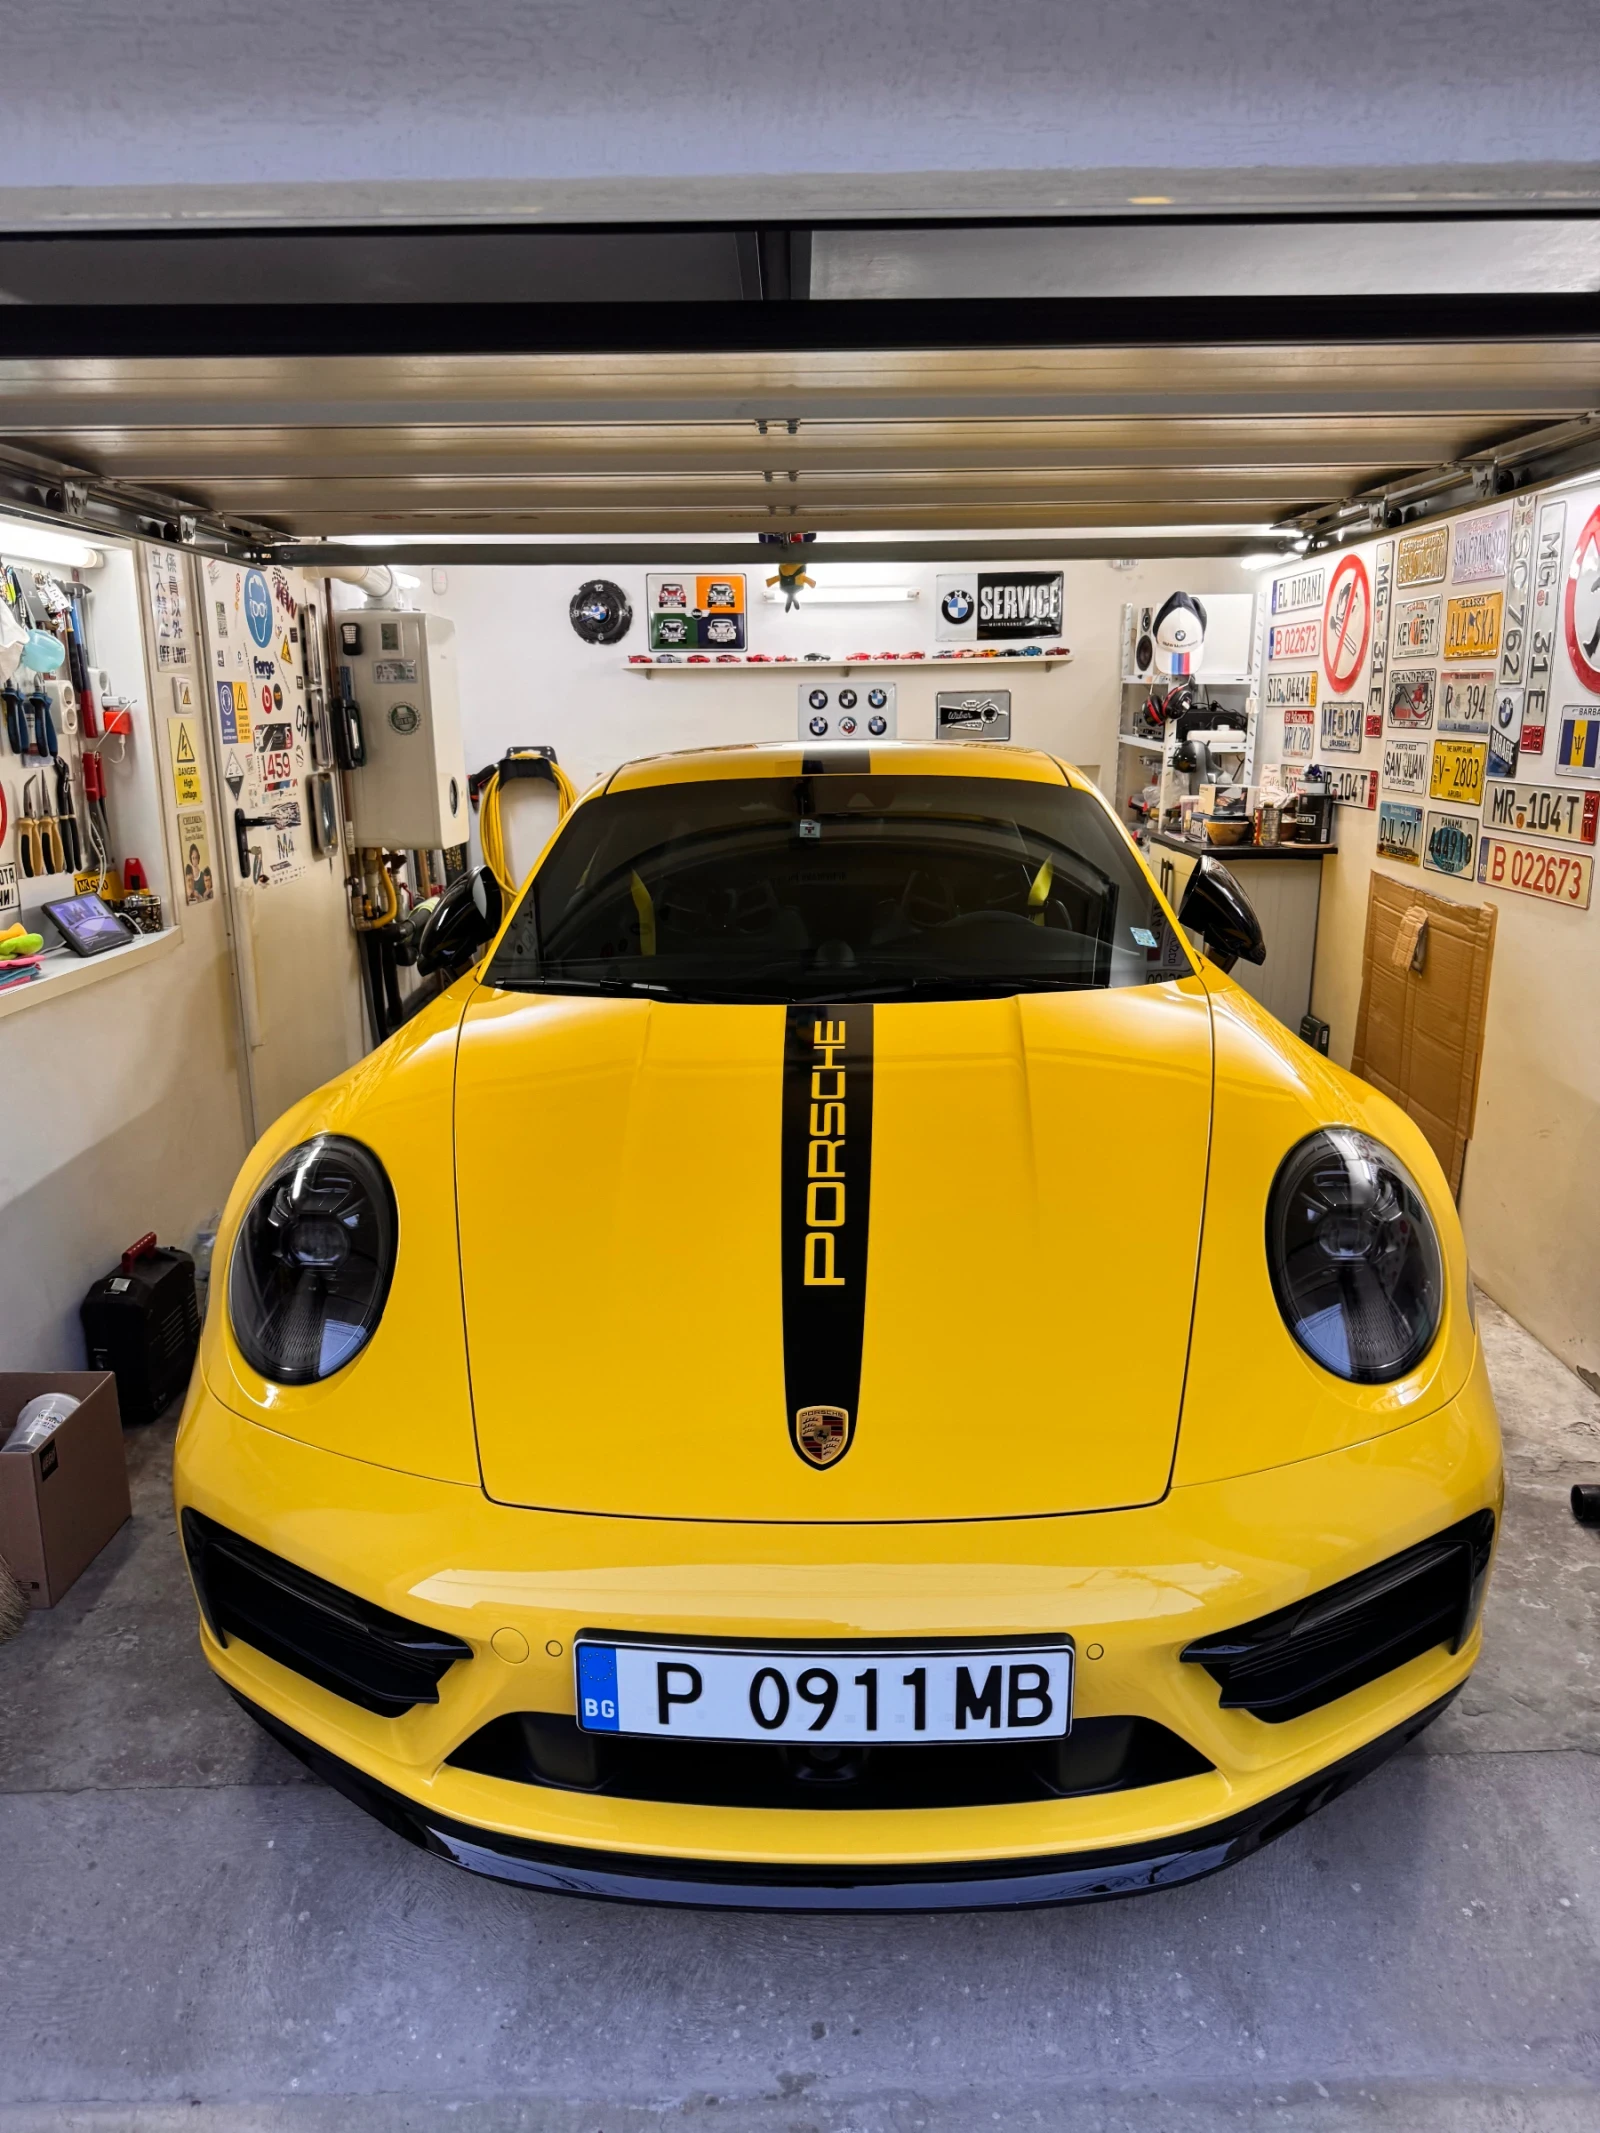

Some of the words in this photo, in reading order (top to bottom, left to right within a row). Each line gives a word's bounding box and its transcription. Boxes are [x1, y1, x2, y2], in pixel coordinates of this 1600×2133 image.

[594, 584, 604, 592] 12
[943, 590, 973, 603] BMW
[980, 585, 1062, 620] SERVICE
[1278, 583, 1288, 609] EL
[1275, 630, 1283, 655] B
[1284, 625, 1317, 654] 022673
[1397, 622, 1412, 647] KEY
[1412, 618, 1435, 645] WEST
[1445, 685, 1454, 719] R
[1464, 685, 1487, 720] 394
[1492, 730, 1515, 765] GARAGE
[178, 767, 197, 776] DANGER
[262, 752, 291, 781] 1459
[1385, 752, 1402, 777] SAN
[1404, 753, 1425, 780] JUAN
[1453, 757, 1480, 788] 2803
[182, 790, 198, 800] voltage
[184, 779, 194, 789] High
[1399, 820, 1418, 849] 371
[1441, 817, 1463, 829] PANAMA
[1491, 845, 1506, 881] B
[1511, 850, 1583, 900] 022673
[804, 1020, 846, 1286] PORSCHE
[584, 1697, 616, 1719] BG
[656, 1661, 702, 1725] P
[749, 1666, 927, 1731] 0911
[955, 1663, 1053, 1730] MB
